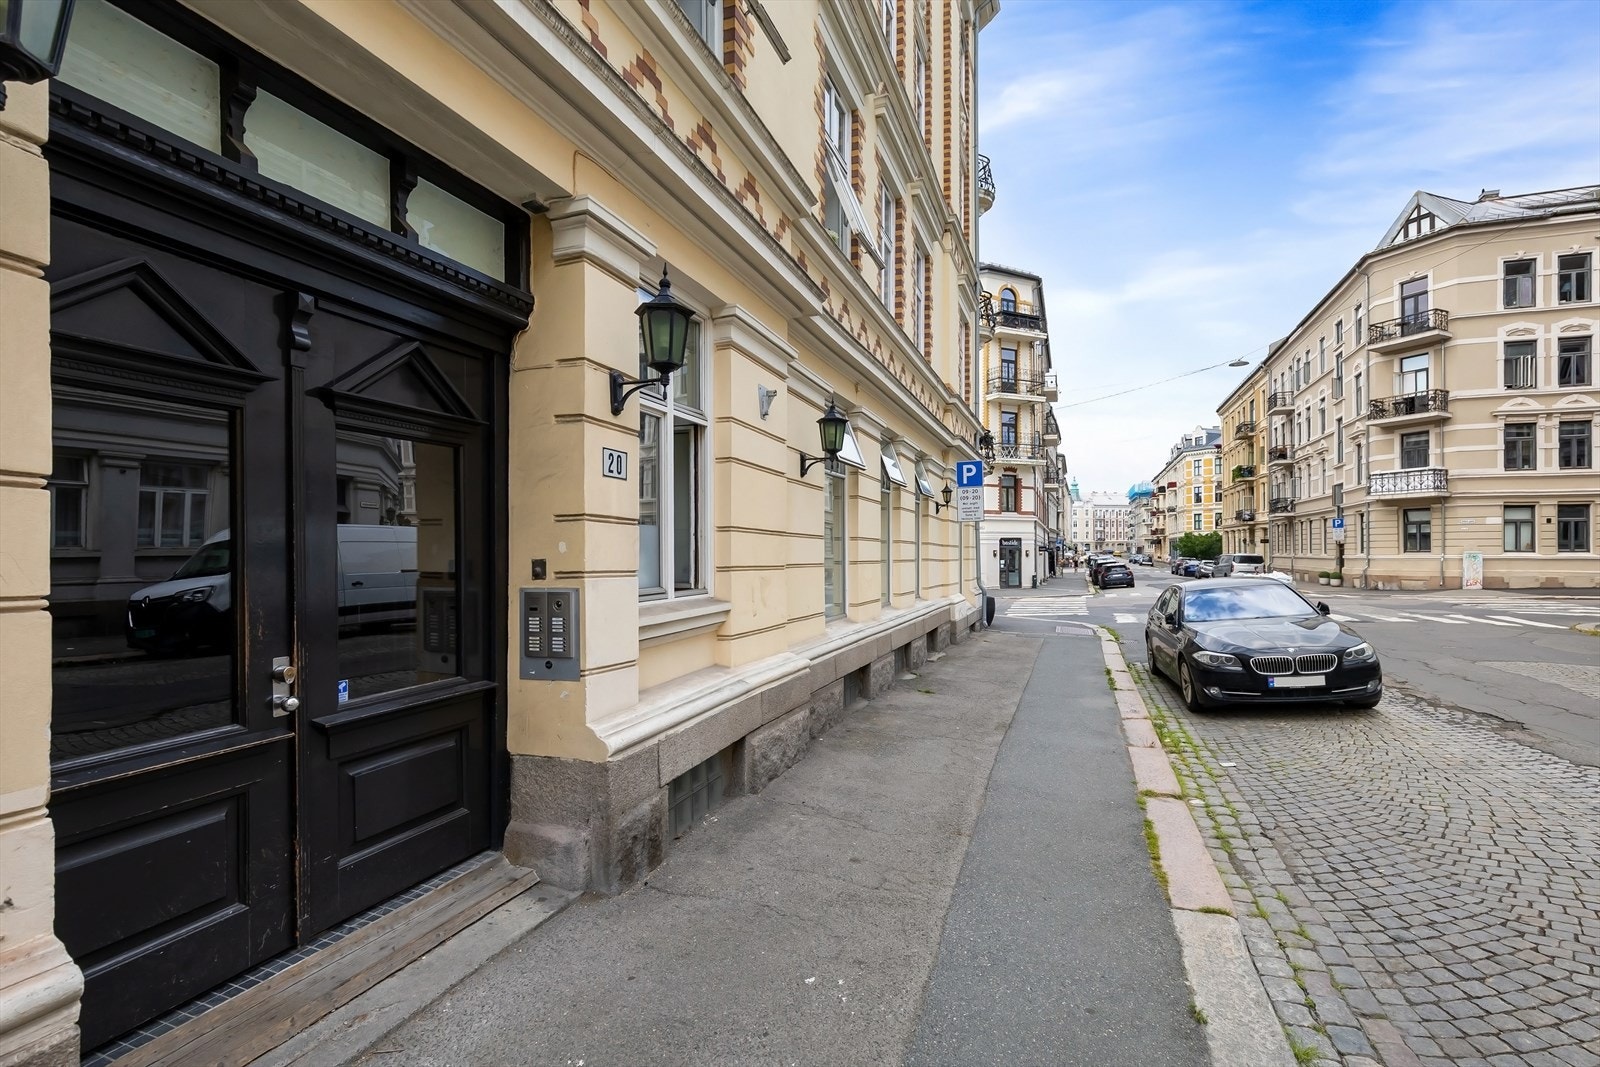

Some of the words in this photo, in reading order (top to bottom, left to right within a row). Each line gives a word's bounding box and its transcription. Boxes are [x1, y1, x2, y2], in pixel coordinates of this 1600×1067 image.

[608, 452, 622, 475] 20
[963, 464, 976, 484] P
[1335, 519, 1342, 527] P
